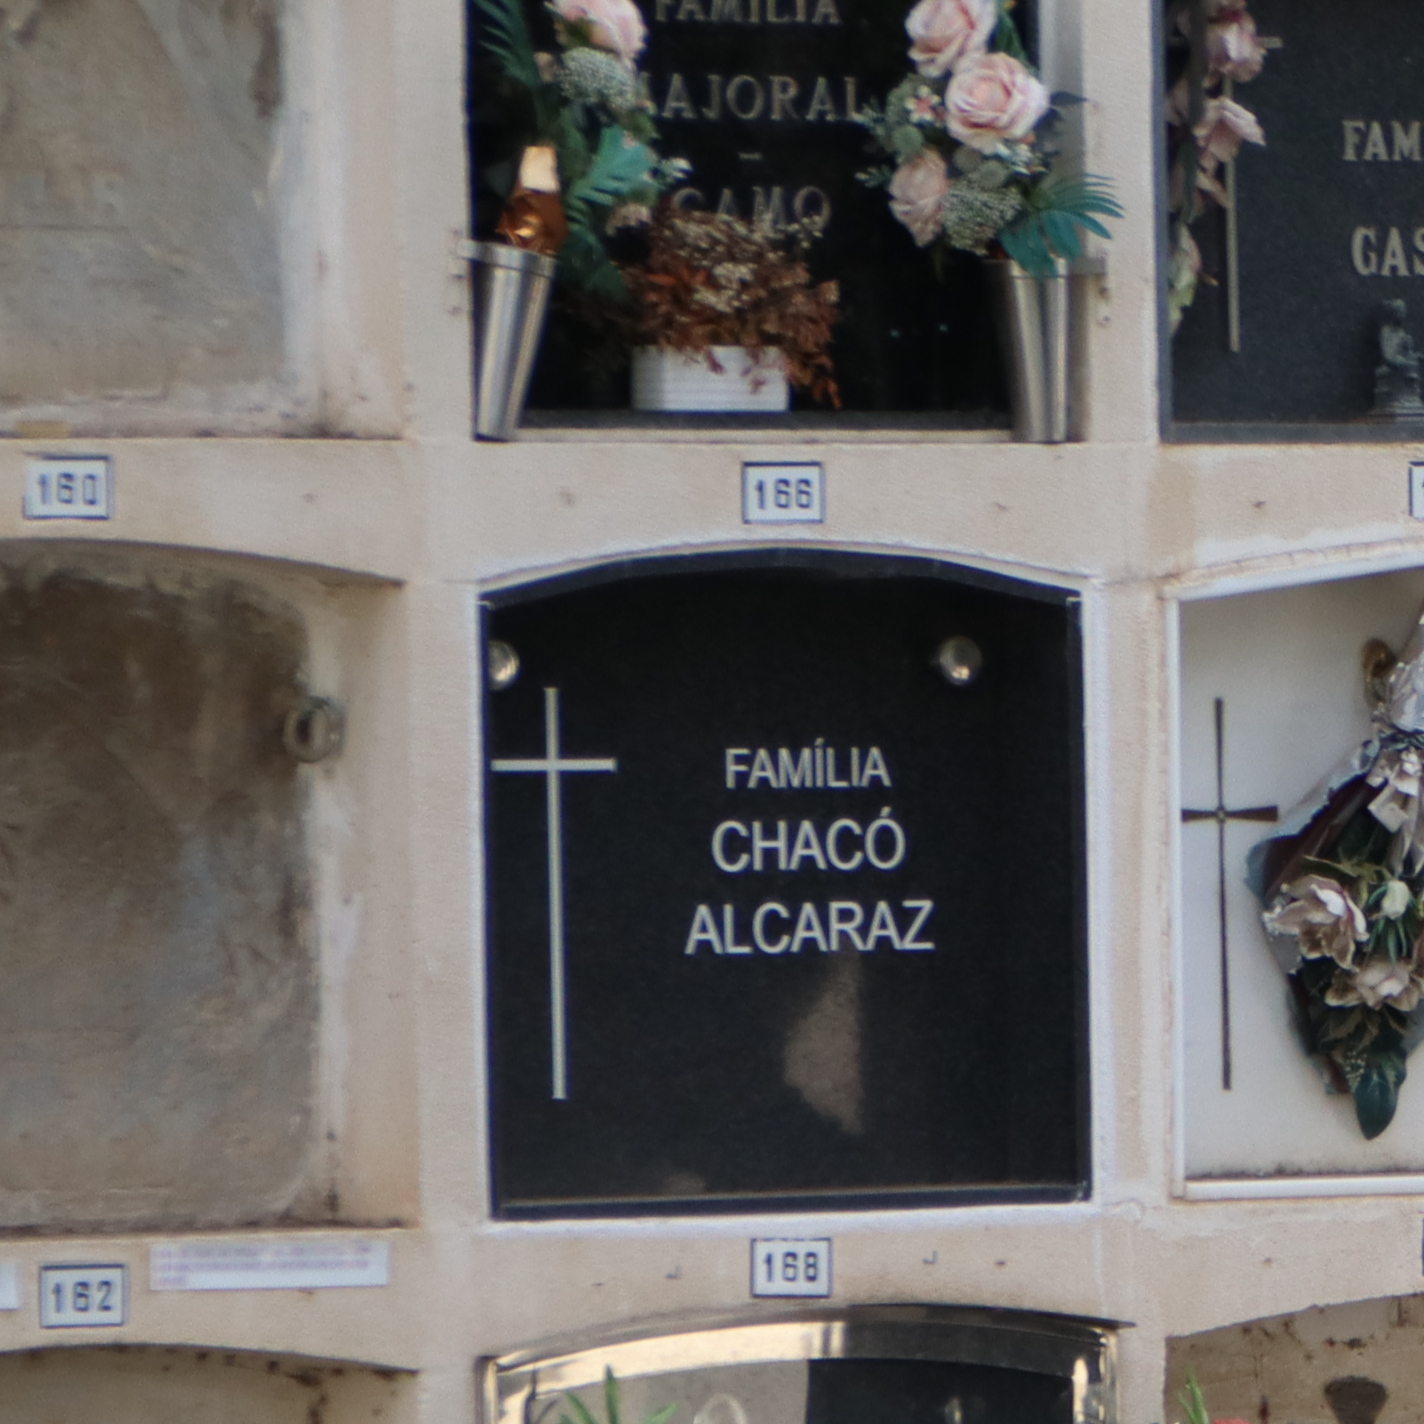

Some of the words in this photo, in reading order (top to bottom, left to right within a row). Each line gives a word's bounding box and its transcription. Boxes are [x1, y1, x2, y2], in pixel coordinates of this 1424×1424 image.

[640, 72, 870, 122] AJORAL
[38, 472, 100, 505] 160
[755, 478, 813, 509] 166
[723, 737, 892, 789] FAMÍLIA
[711, 807, 907, 873] CHACÓ
[684, 899, 935, 956] ALCARAZ
[762, 1251, 819, 1283] 168
[52, 1279, 114, 1314] 162
